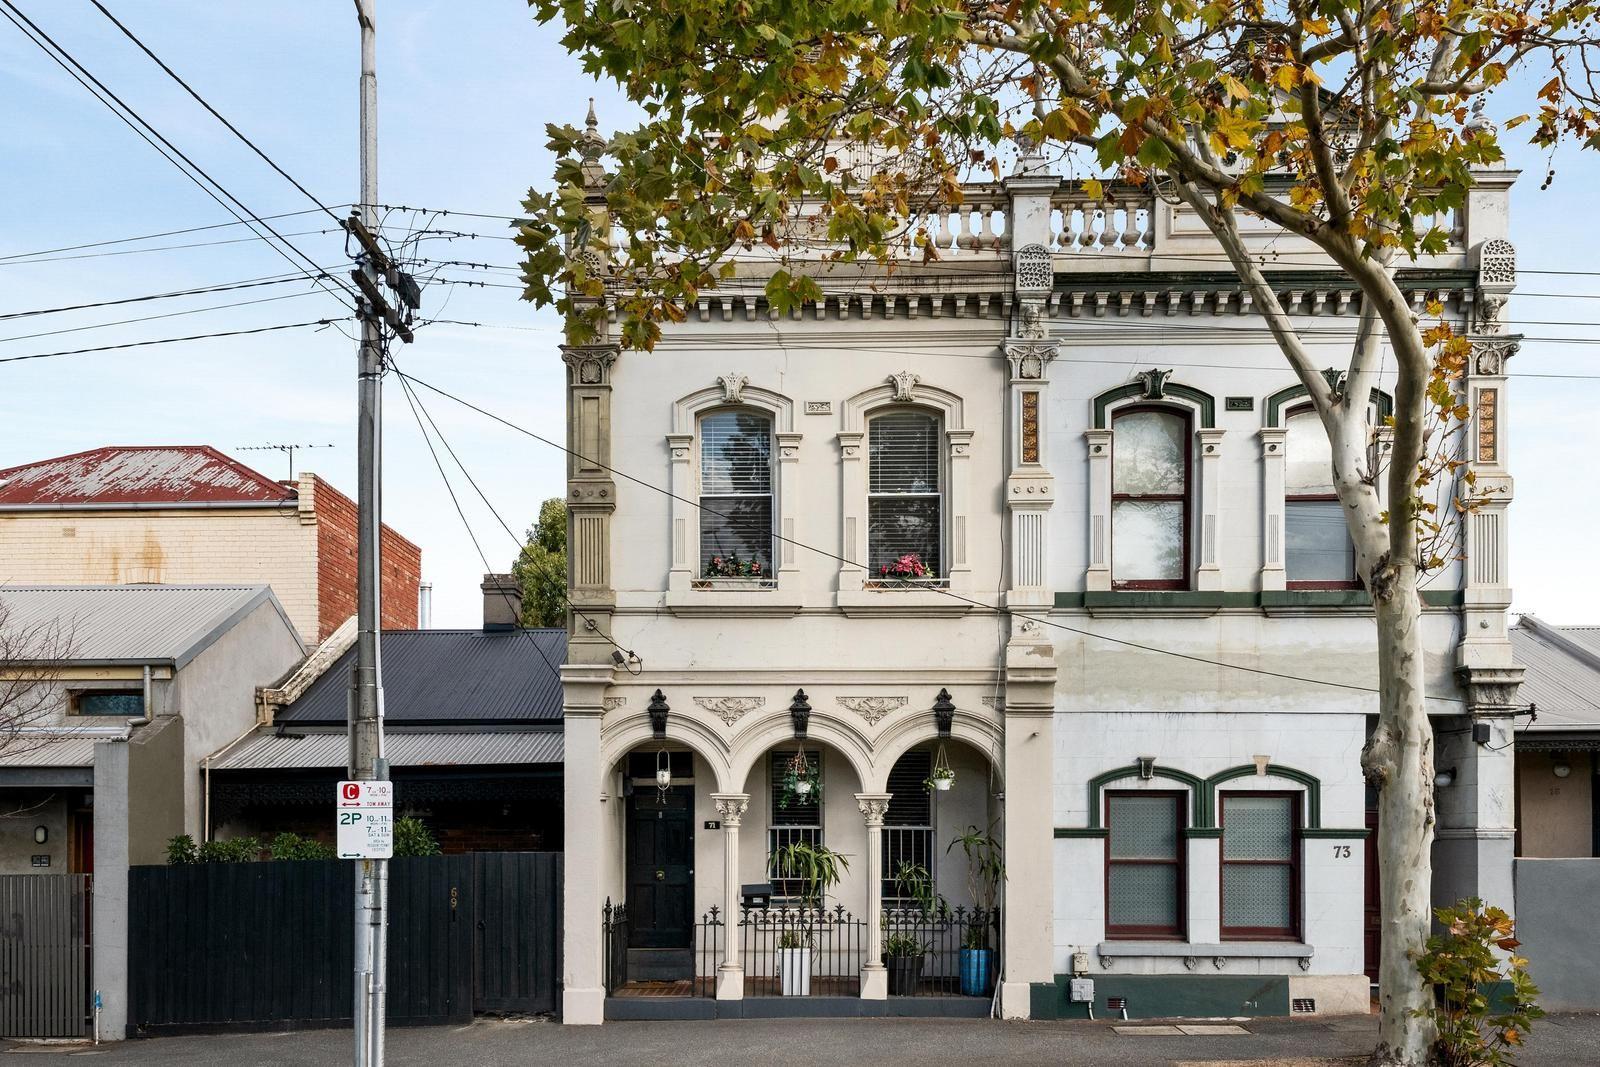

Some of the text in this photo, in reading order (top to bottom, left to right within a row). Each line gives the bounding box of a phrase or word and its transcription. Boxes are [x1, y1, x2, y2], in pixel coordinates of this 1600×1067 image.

[347, 785, 356, 799] C
[340, 813, 362, 825] 2P
[1333, 846, 1351, 859] 73
[450, 887, 458, 908] 69
